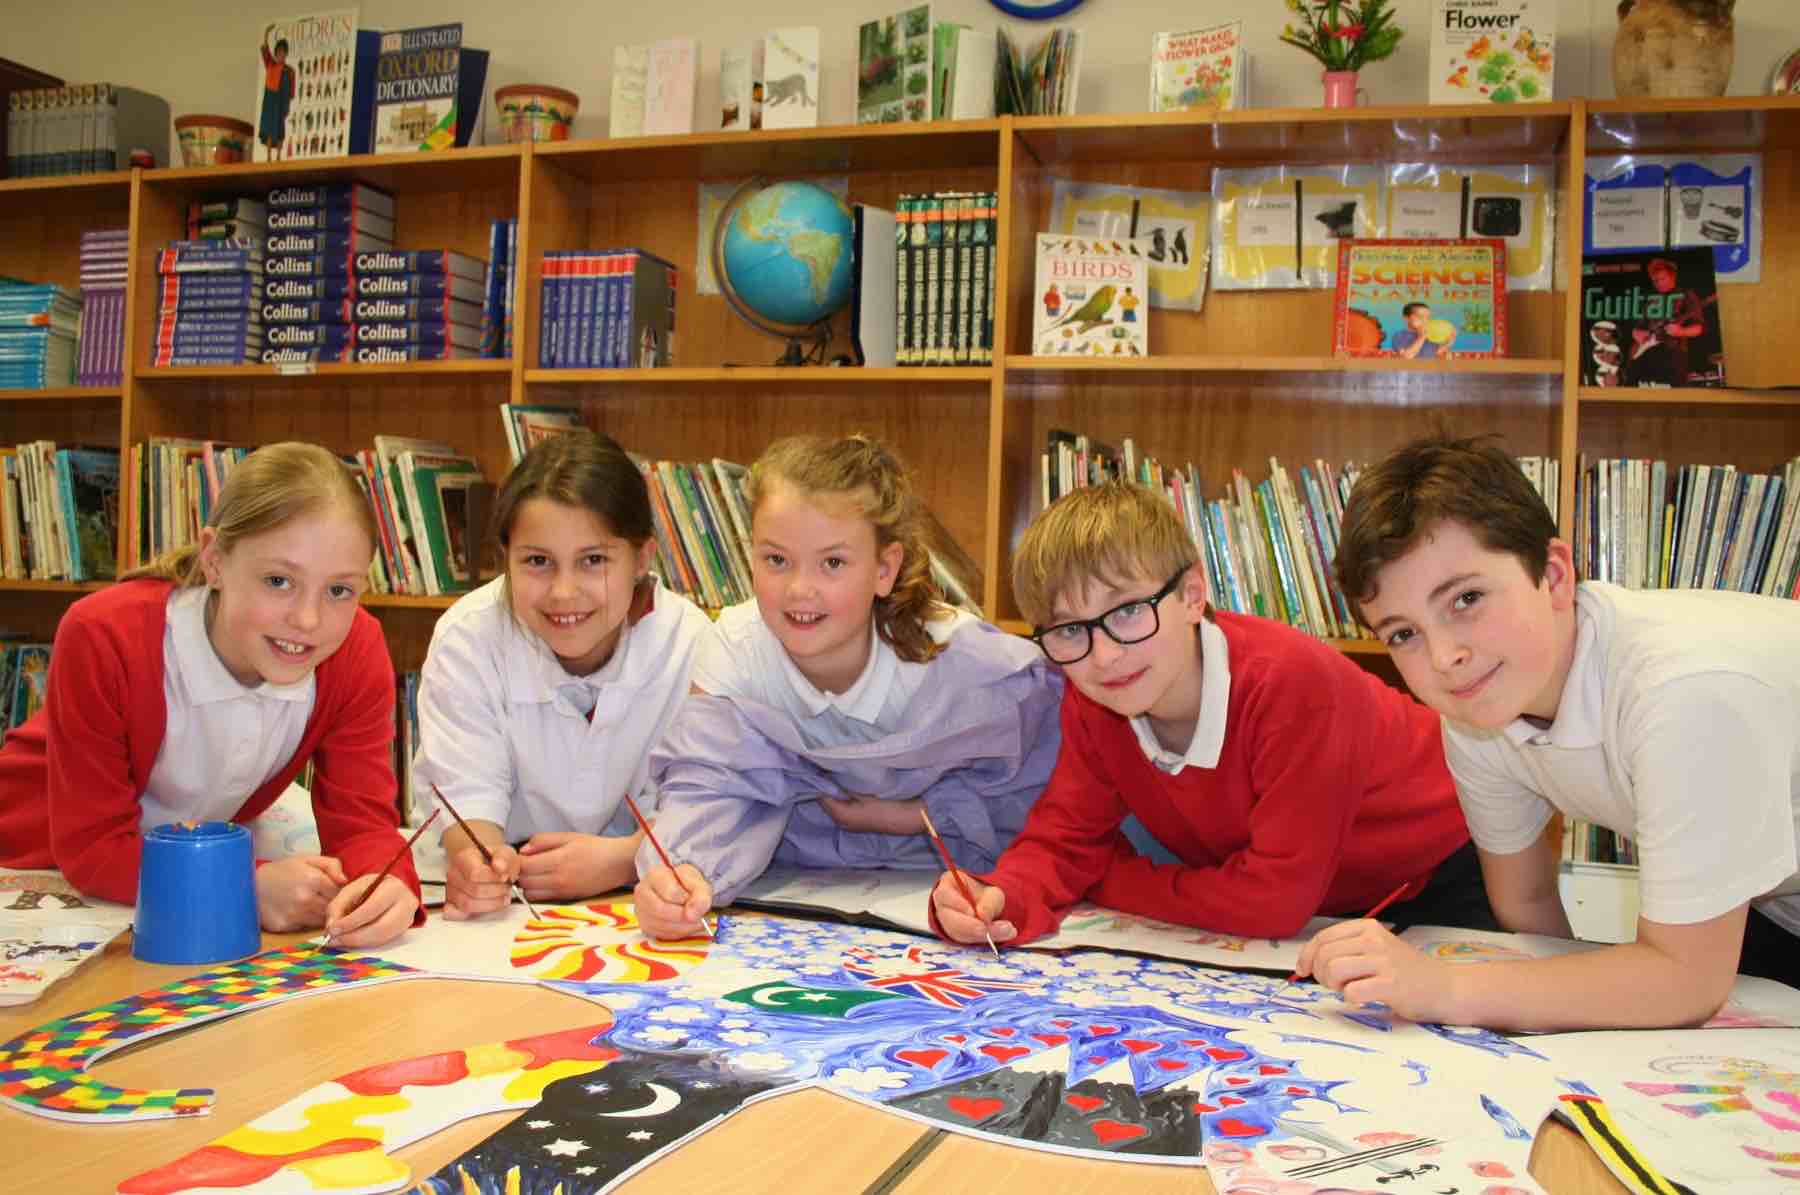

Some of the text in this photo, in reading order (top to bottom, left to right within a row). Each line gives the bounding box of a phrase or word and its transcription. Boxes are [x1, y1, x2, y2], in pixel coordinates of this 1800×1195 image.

[1445, 9, 1520, 28] Flower
[404, 29, 460, 48] ILLUSTRATED
[379, 49, 459, 80] OXFORD
[377, 74, 458, 100] DICTIONARY
[269, 188, 315, 205] Collins
[268, 211, 315, 229] Collins
[267, 234, 314, 252] Collins
[266, 257, 312, 274] Collins
[357, 253, 405, 271] Collins
[1052, 260, 1133, 278] BIRDS
[1351, 264, 1492, 286] SCIENCE
[266, 280, 312, 298] Collins
[359, 276, 408, 294] Collins
[356, 299, 406, 317] Collins
[1585, 286, 1685, 320] Guitar
[263, 304, 308, 321] Collins
[268, 326, 314, 344] Collins
[358, 323, 407, 341] Collins
[262, 350, 307, 362] Collins
[358, 346, 407, 363] Collins
